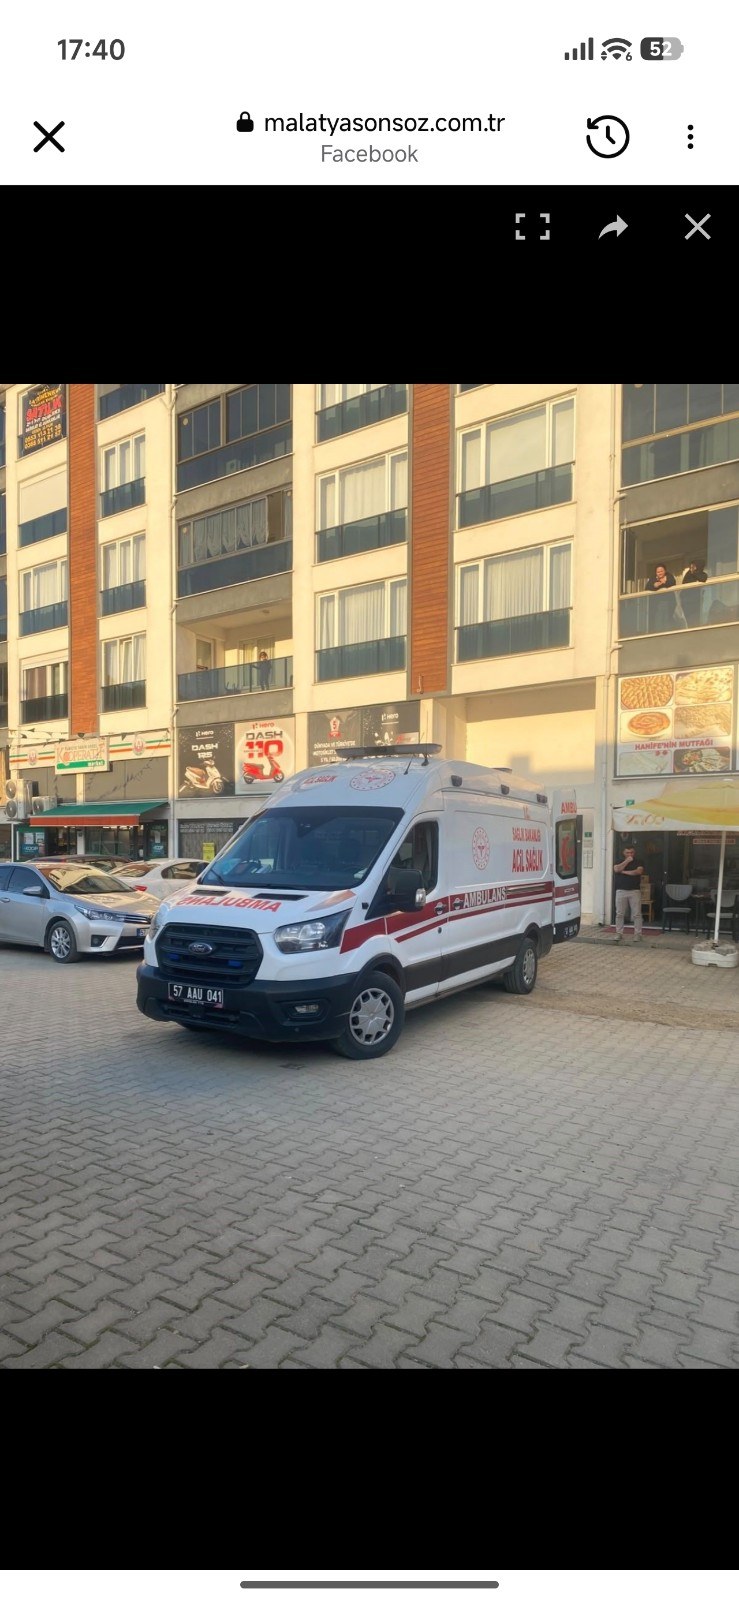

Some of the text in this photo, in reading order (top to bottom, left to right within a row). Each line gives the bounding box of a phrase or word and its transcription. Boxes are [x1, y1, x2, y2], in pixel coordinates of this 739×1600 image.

[57, 38, 126, 61] 17:40
[650, 41, 673, 57] 52
[264, 112, 506, 137] malatyasonsoz.com.tr
[320, 144, 419, 163] Facebook
[245, 730, 284, 741] DASH
[635, 739, 713, 751] HANİFE'NİN MUTFAĞI
[191, 743, 219, 752] DASH
[245, 739, 284, 760] 110
[512, 848, 525, 873] ACİL
[463, 886, 507, 909] AMBULANS
[173, 985, 183, 997] 57
[187, 987, 203, 1001] AAU
[206, 989, 222, 1003] 041
